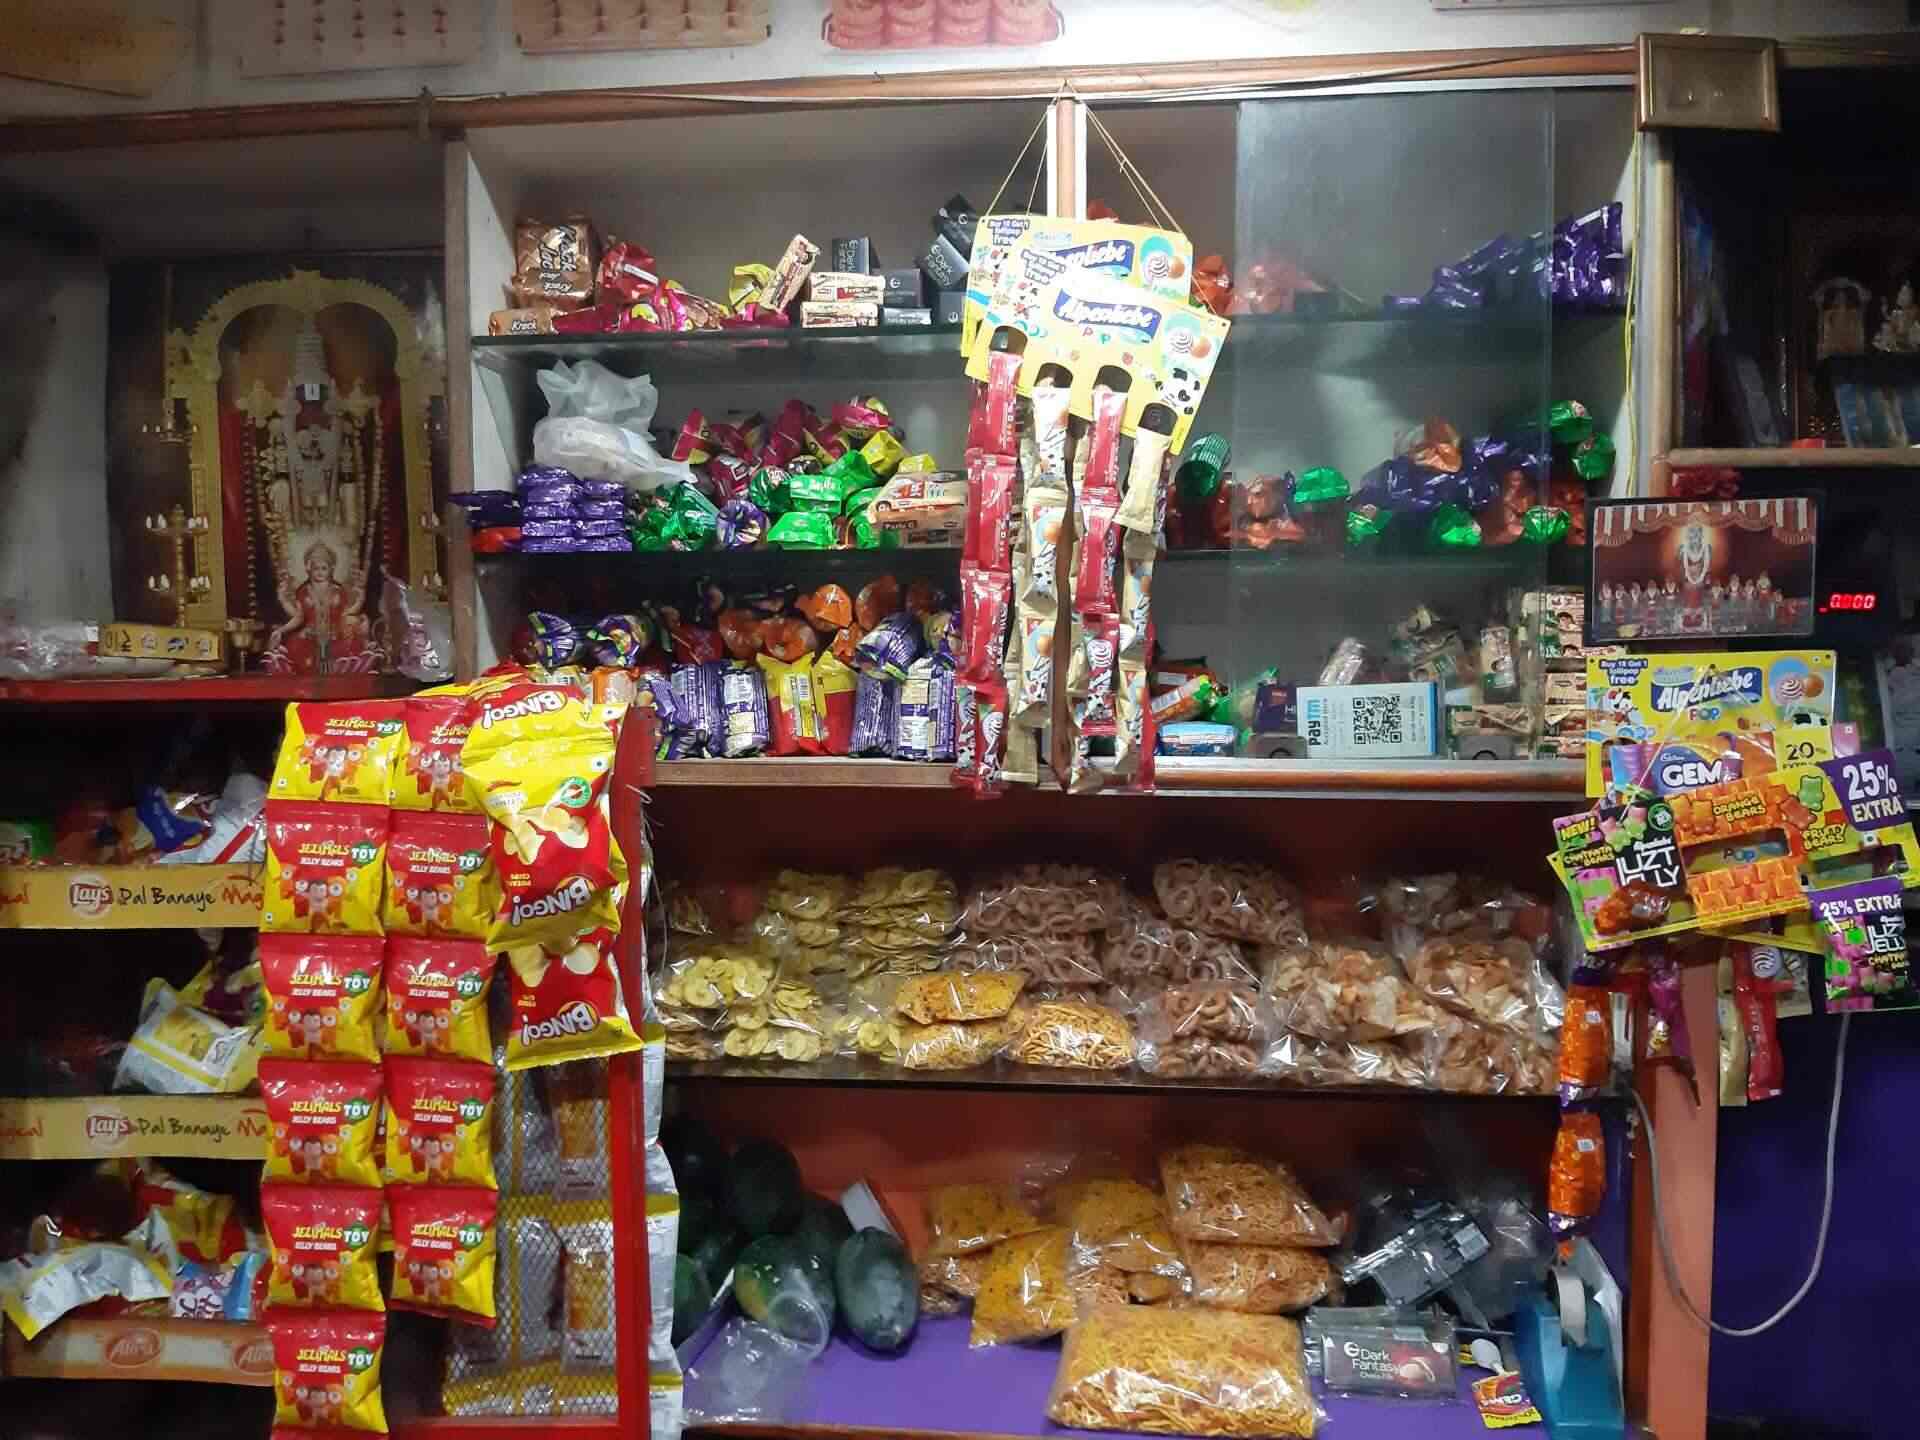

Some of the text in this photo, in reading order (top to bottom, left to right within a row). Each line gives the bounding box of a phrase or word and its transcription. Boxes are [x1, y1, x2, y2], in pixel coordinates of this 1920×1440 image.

[538, 243, 559, 273] Jac
[1657, 670, 1753, 710] Alpenliebe
[481, 691, 564, 729] BINGO!
[1689, 707, 1720, 721] POP
[377, 723, 402, 733] TOY
[1662, 760, 1723, 786] GEM
[1842, 760, 1897, 800] 25%
[1851, 796, 1904, 823] EXTRA
[1560, 817, 1598, 841] NEW!
[351, 848, 377, 859] TOY
[459, 856, 484, 868] TOY
[151, 886, 216, 911] Banaye
[512, 877, 592, 926] BINGO!
[1820, 900, 1854, 917] 25%
[343, 978, 370, 989] TOY
[457, 981, 483, 993] TOY
[521, 1003, 594, 1045] BINGO!
[343, 1104, 370, 1116] TOY
[459, 1105, 484, 1117] TOY
[137, 1116, 164, 1136] Pal
[170, 1118, 230, 1143] Banaye
[343, 1230, 369, 1243] TOY
[459, 1230, 484, 1243] TOY
[348, 1353, 374, 1366] TOY
[1360, 1348, 1391, 1361] Dark
